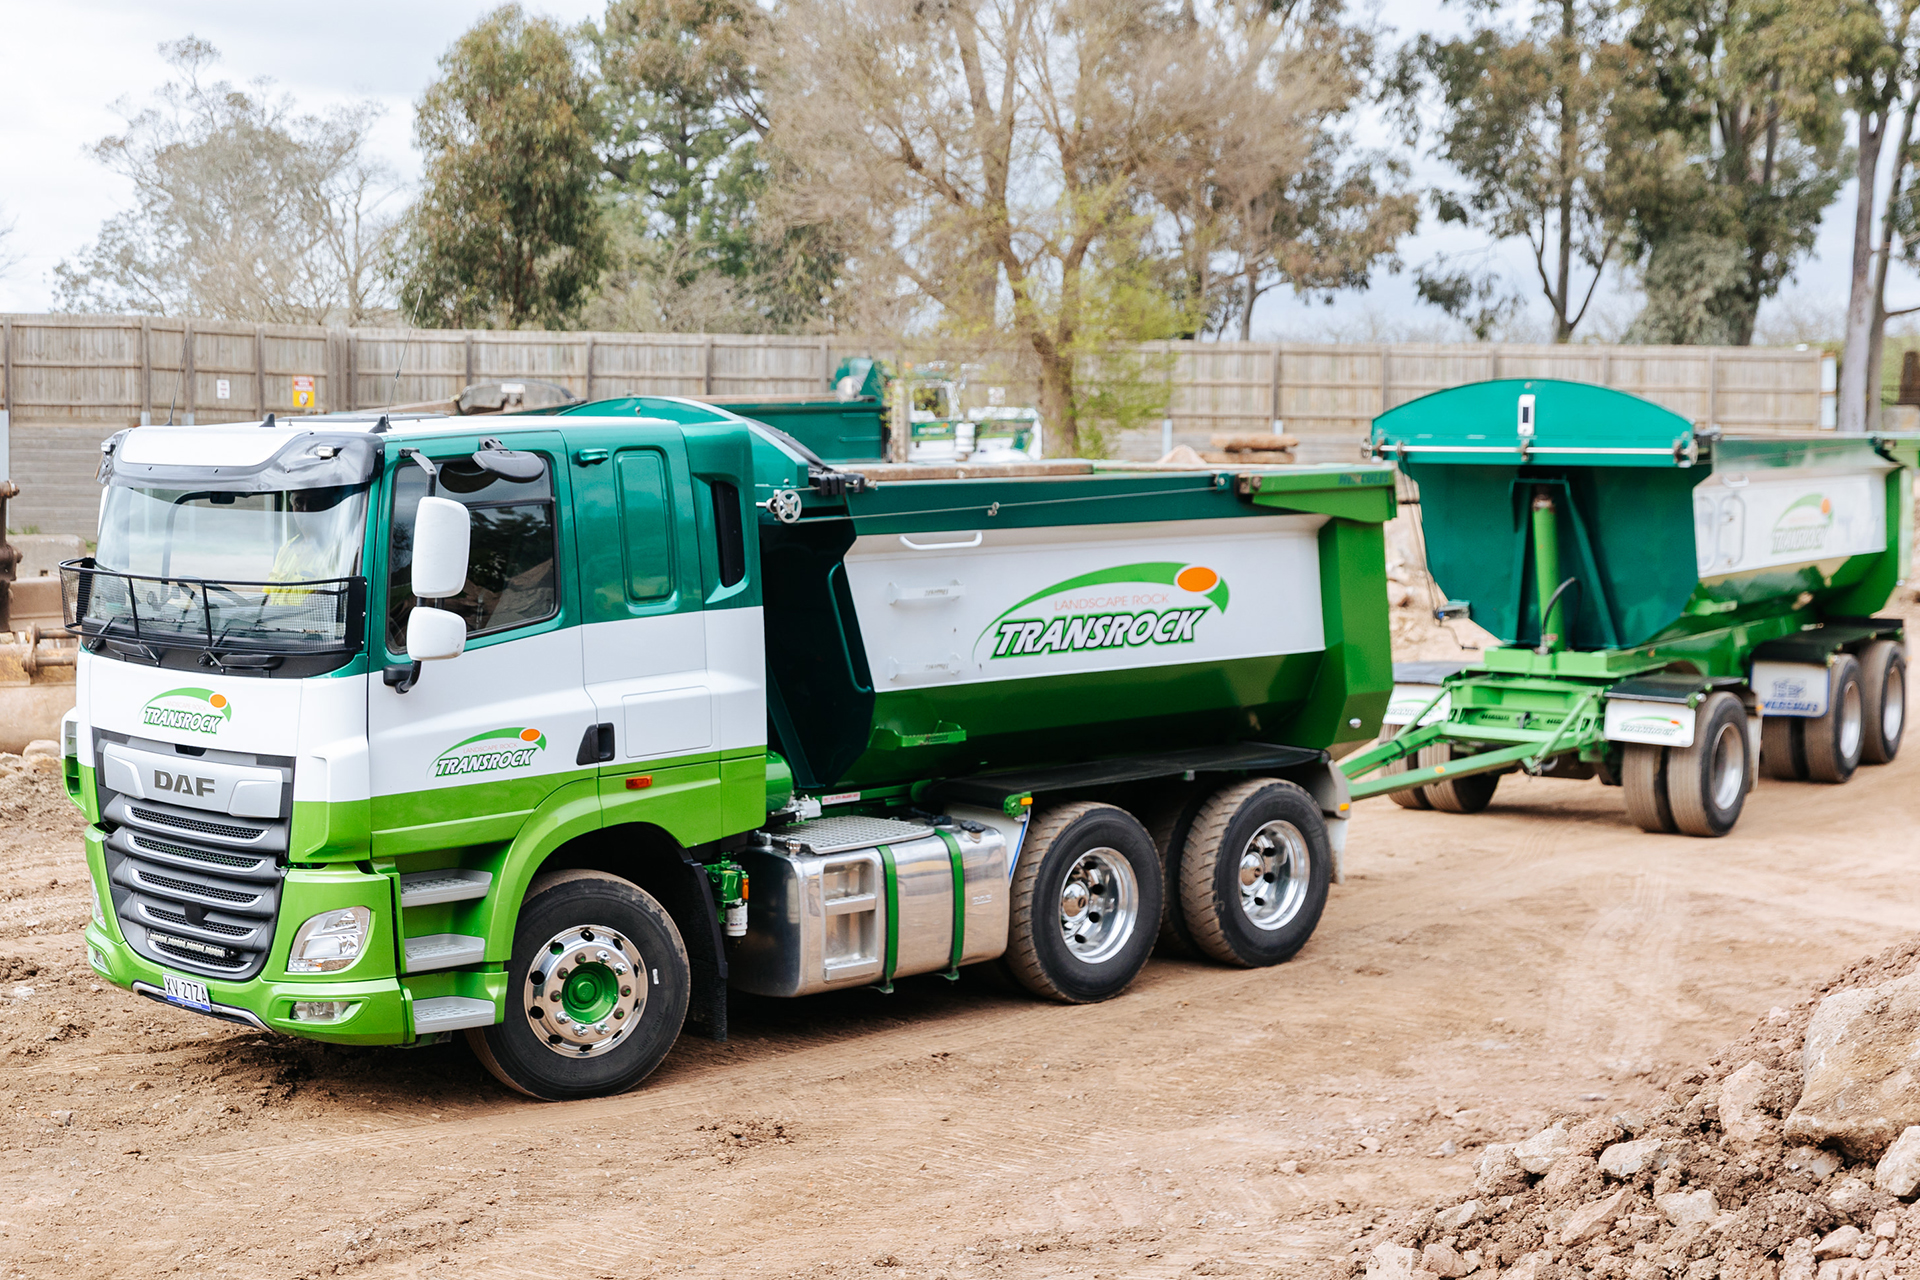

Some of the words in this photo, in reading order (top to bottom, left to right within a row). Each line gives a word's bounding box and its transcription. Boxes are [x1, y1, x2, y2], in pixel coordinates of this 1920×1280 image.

[1054, 595, 1128, 611] LANDSCAPE
[1132, 593, 1170, 605] ROCK
[990, 606, 1213, 659] TRANSROCK
[143, 706, 224, 734] TRANSROCK
[435, 747, 539, 777] TRANSROCK
[462, 744, 498, 754] LANDSCAPE
[499, 742, 518, 750] ROCK
[154, 769, 215, 797] DAF
